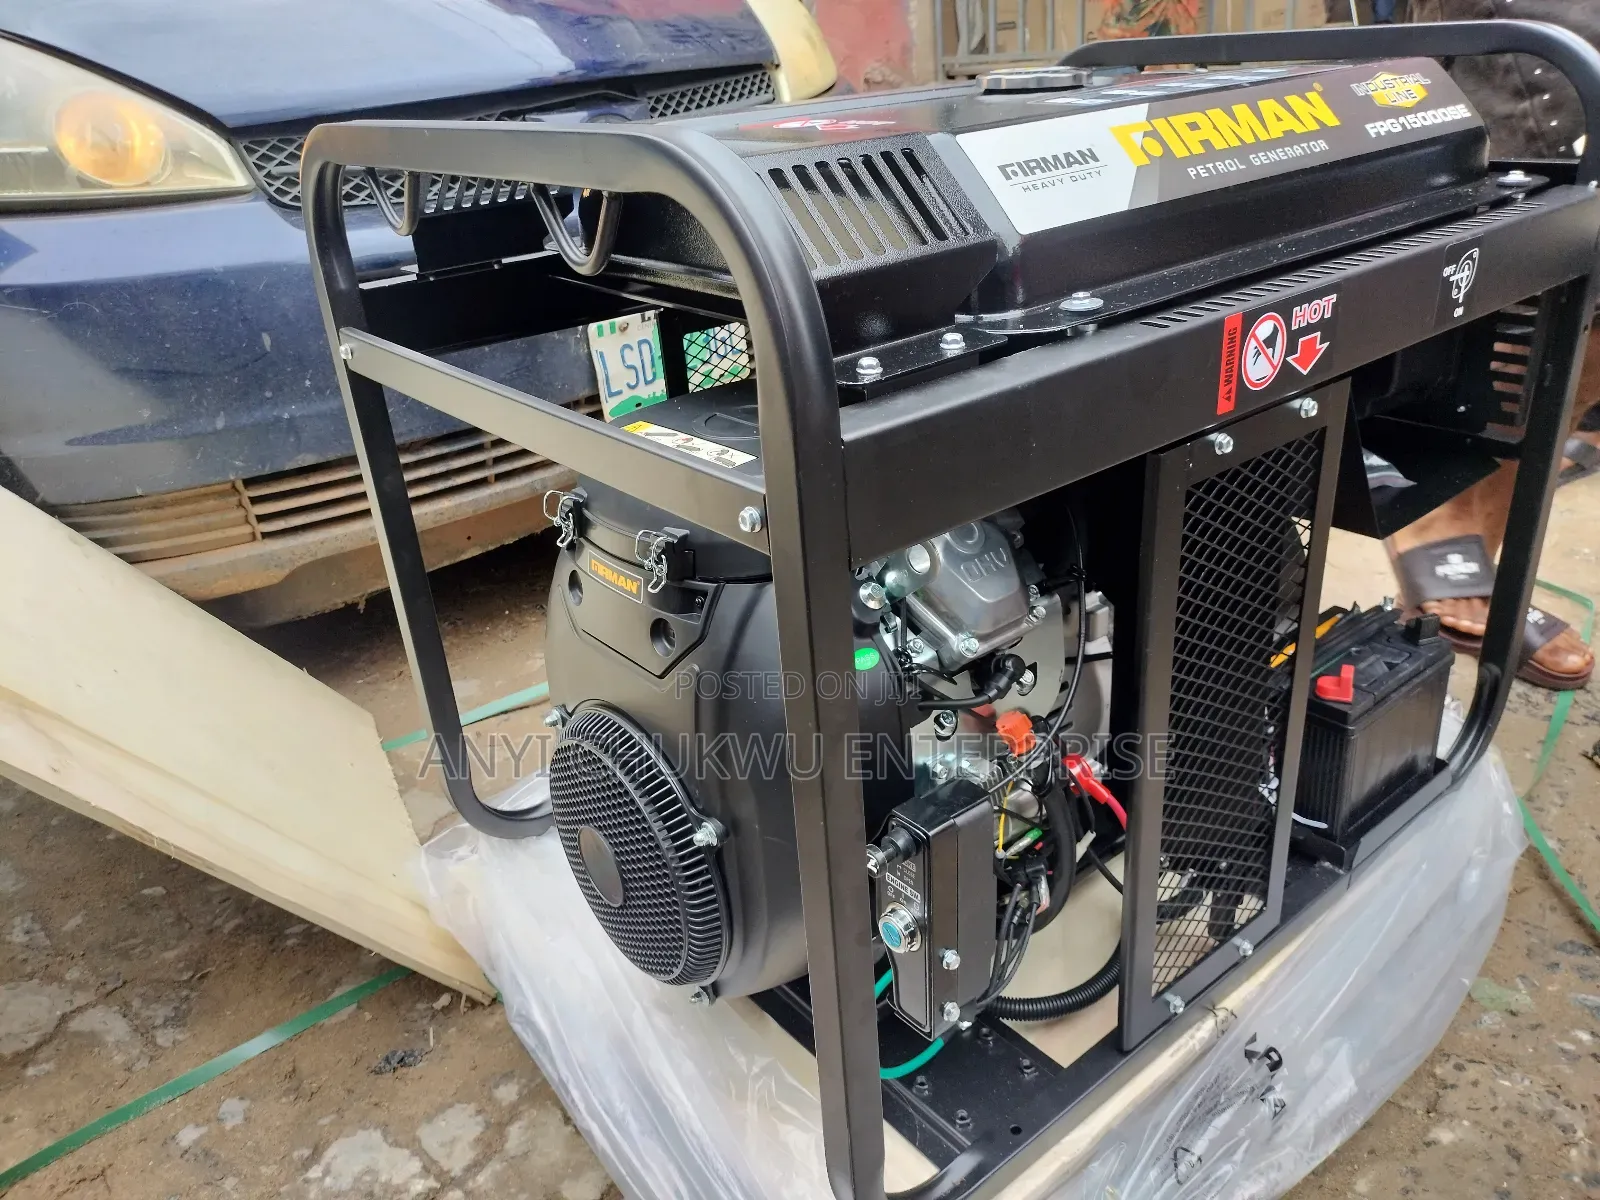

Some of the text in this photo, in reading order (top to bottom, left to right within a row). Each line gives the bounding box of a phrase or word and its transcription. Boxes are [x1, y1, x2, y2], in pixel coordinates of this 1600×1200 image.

[1350, 72, 1431, 97] INDUSTRIAL
[1384, 88, 1420, 105] LINE
[1364, 103, 1472, 138] FPG15000SE
[1186, 138, 1330, 180] PETROL GENERATOR
[1021, 169, 1105, 193] HEAVY DUTY
[1443, 264, 1457, 277] OFF
[1291, 293, 1338, 330] HOT
[1223, 326, 1238, 387] WARNING
[960, 547, 1008, 583] OHV
[887, 874, 910, 894] ENGINE
